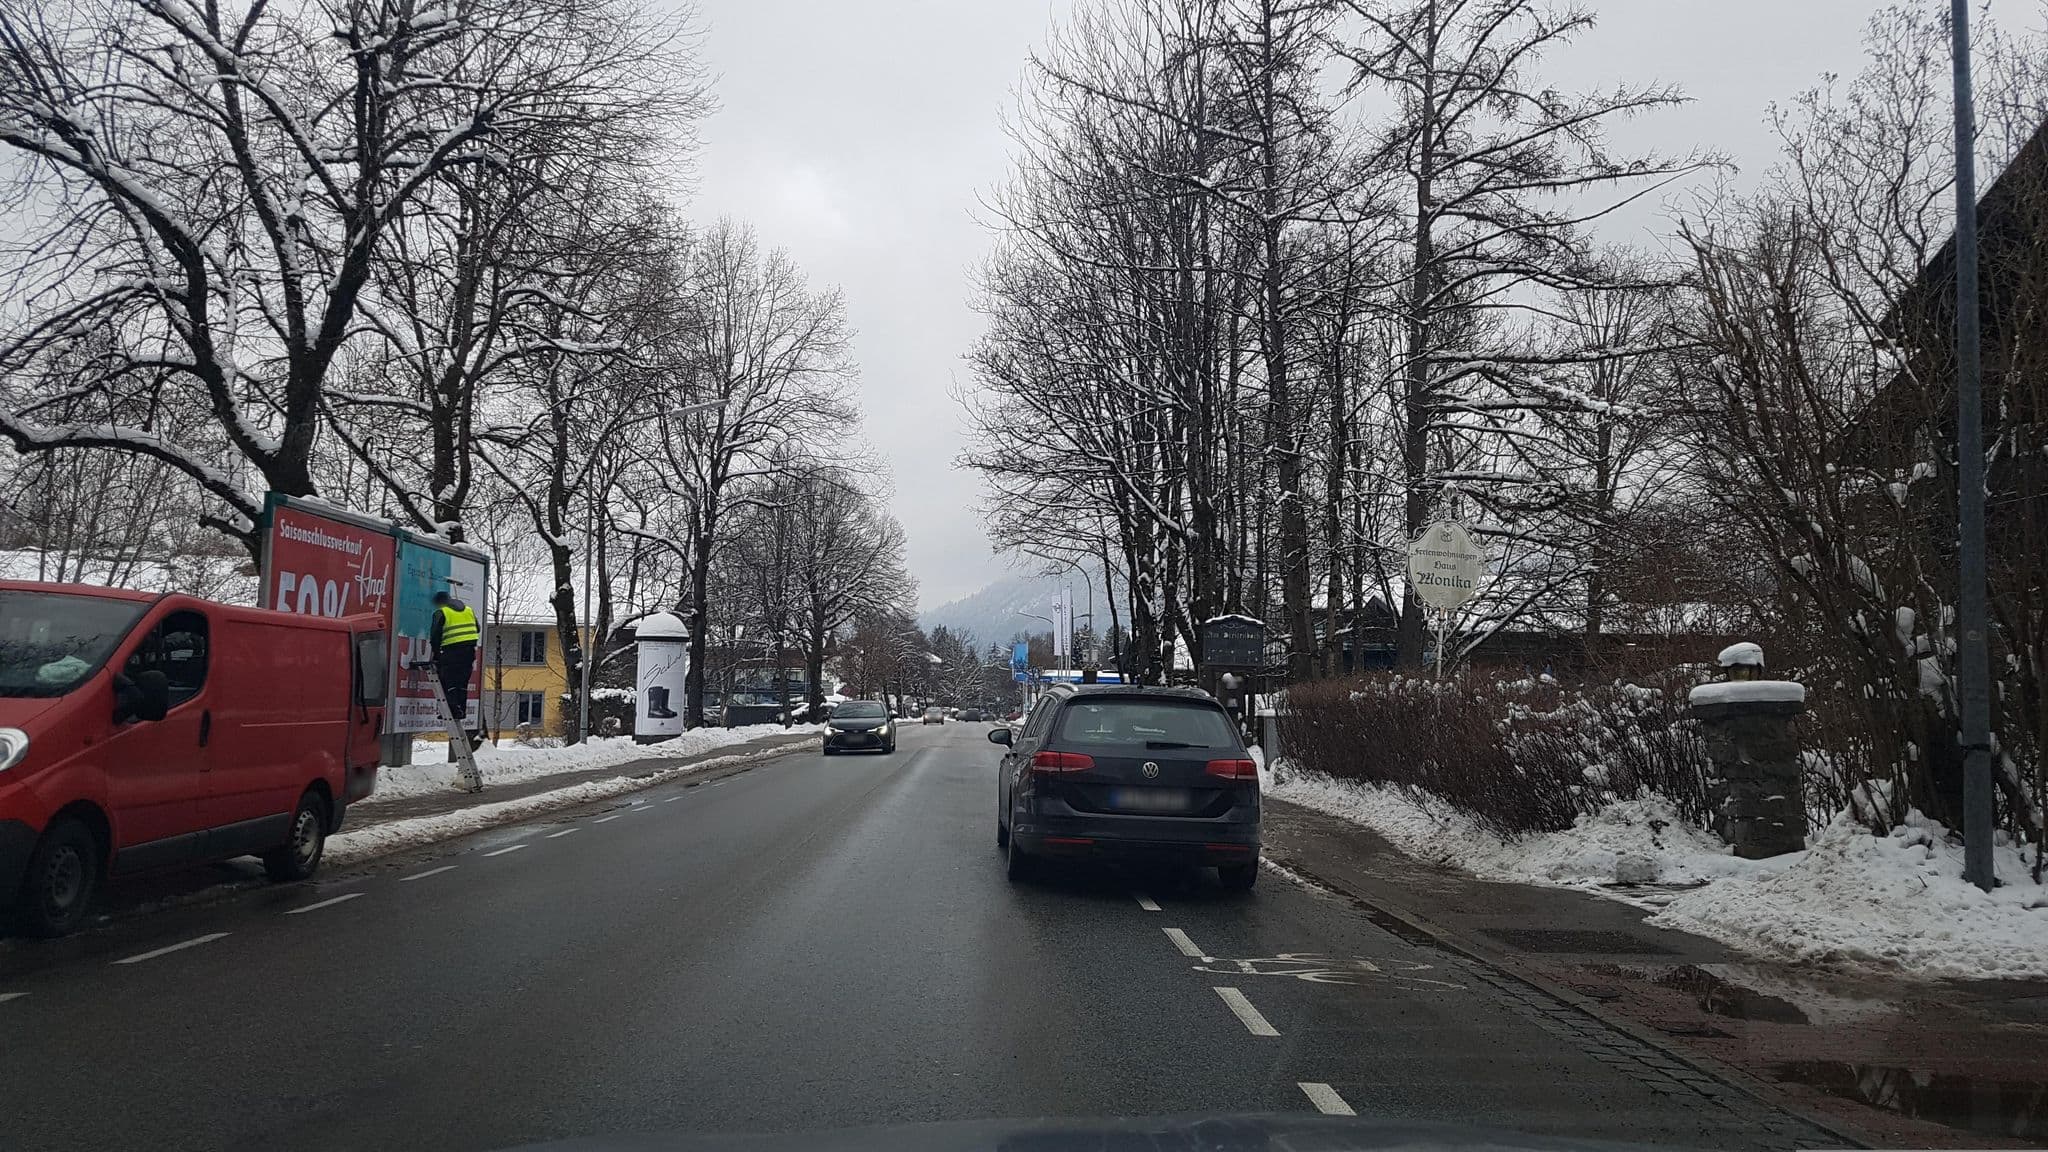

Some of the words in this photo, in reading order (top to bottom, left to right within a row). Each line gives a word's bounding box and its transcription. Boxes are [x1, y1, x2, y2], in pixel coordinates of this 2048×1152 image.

[279, 518, 363, 556] Saisonschlussverkauf
[1411, 546, 1478, 561] Ferienwohnungen
[1433, 561, 1457, 571] Haus
[1416, 570, 1472, 589] Monika
